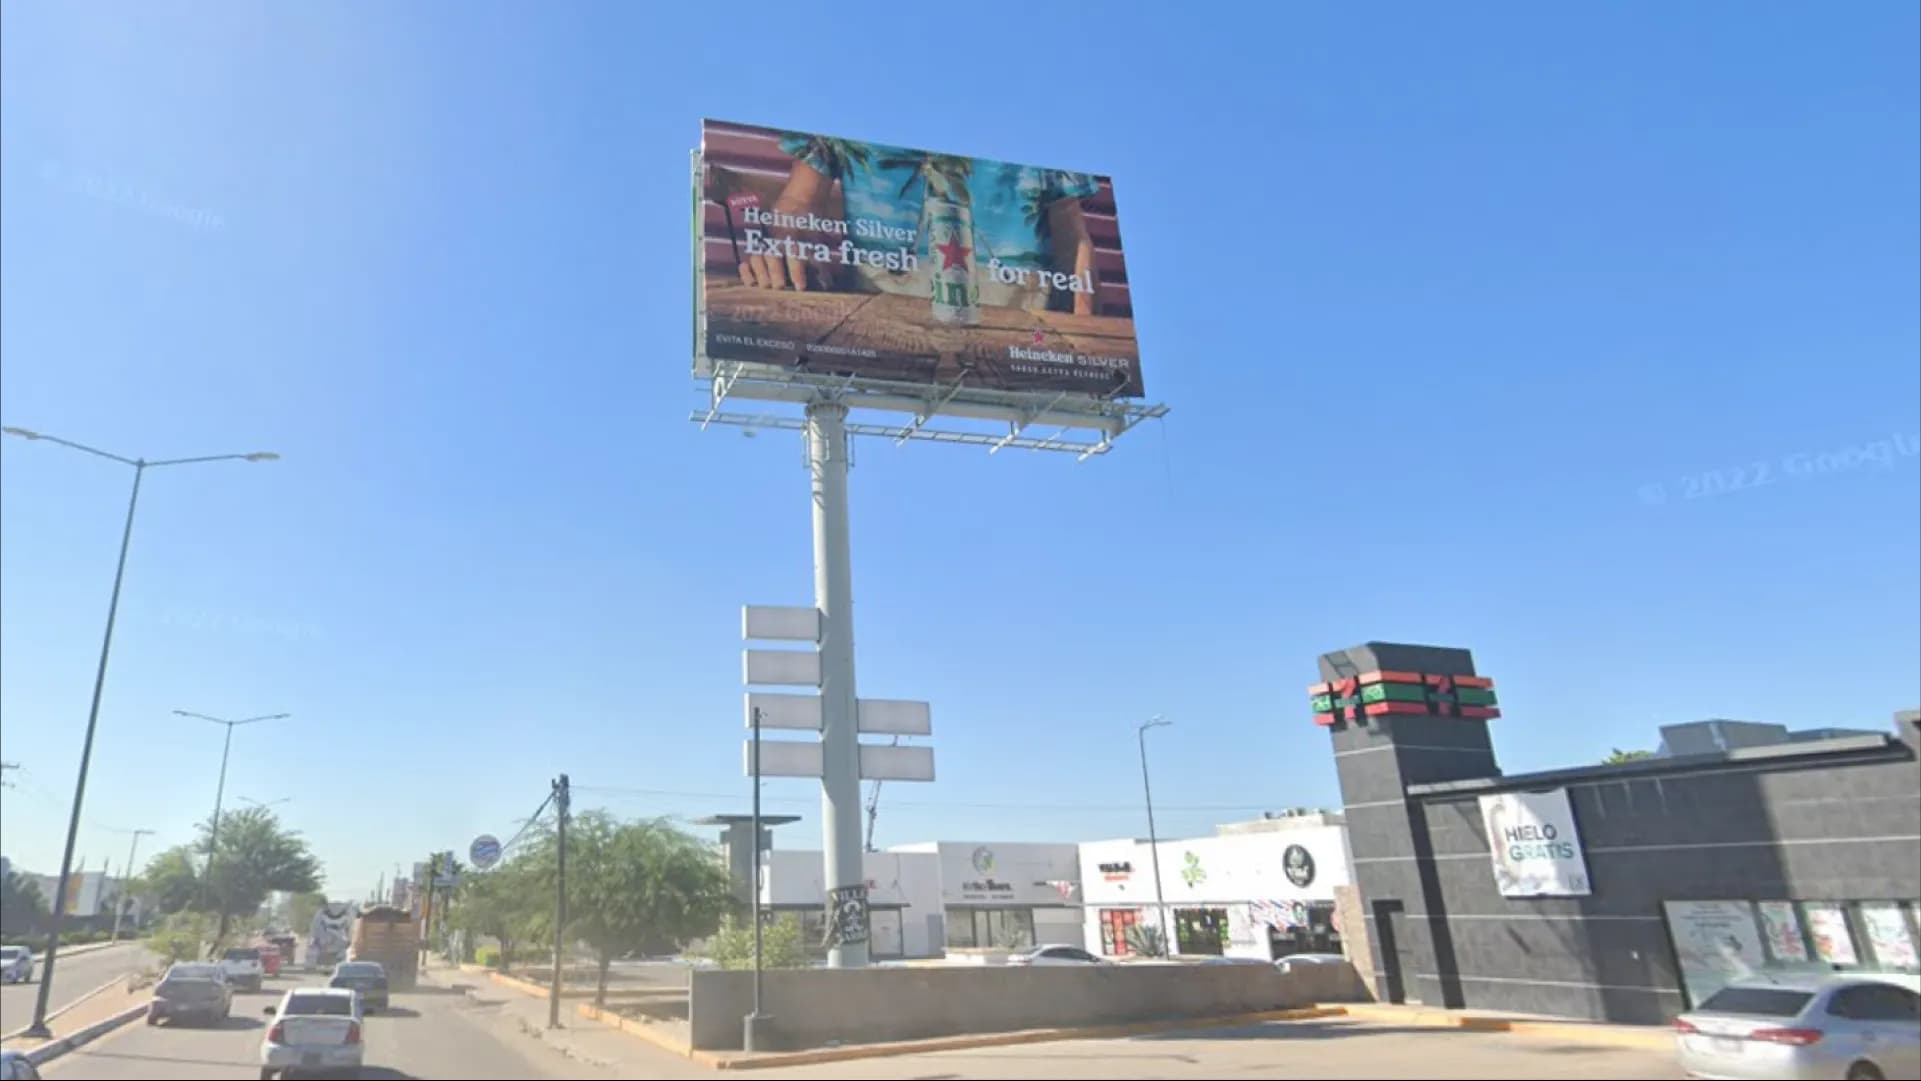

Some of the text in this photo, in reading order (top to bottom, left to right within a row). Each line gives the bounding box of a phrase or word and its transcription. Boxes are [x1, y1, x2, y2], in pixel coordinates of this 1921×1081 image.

[743, 207, 848, 235] Heineken
[856, 218, 917, 243] Silver
[743, 229, 918, 272] Extra fresh
[987, 257, 1095, 294] for real
[715, 333, 795, 350] EVITA EL EXCESO
[1008, 345, 1130, 369] Heineken SILVER
[1504, 823, 1558, 842] HIELO
[1509, 841, 1575, 862] GRATIS
